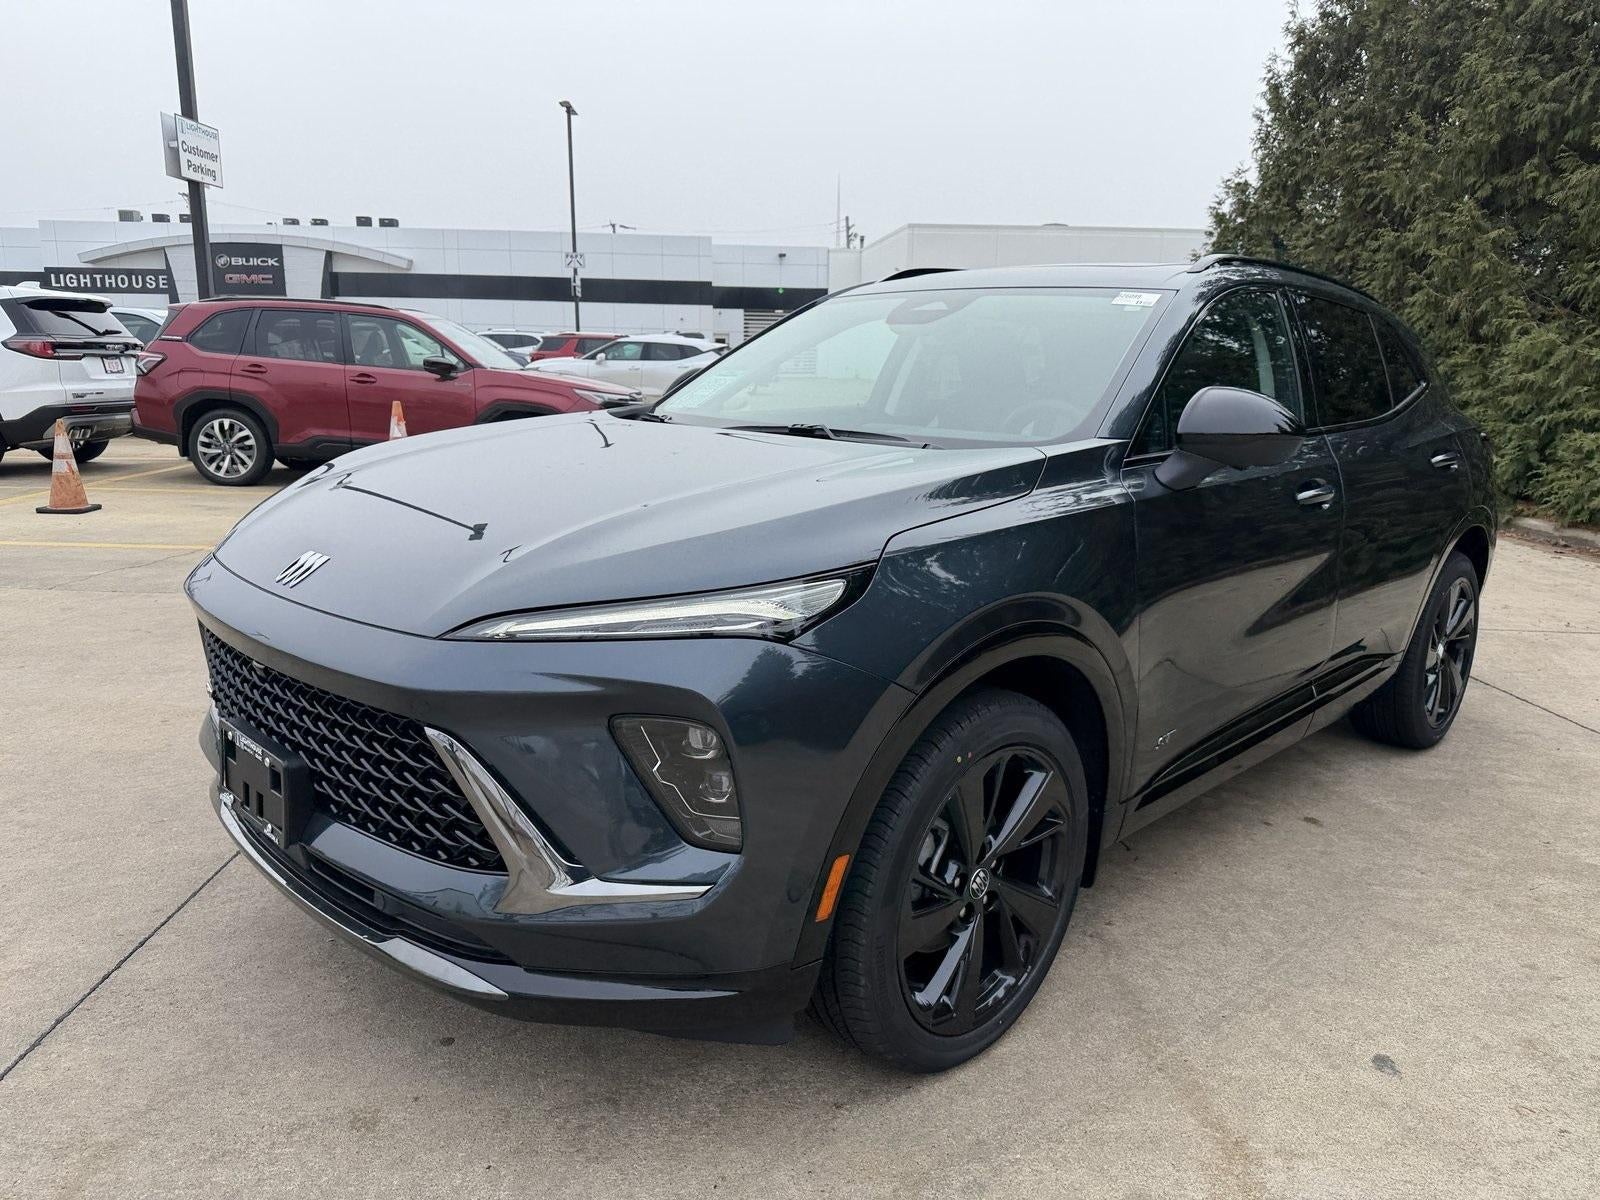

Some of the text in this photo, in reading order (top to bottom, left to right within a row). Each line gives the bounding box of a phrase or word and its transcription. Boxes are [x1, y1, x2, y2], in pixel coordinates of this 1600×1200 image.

[181, 140, 218, 163] Customer
[186, 159, 217, 181] Parking
[231, 256, 280, 267] BUICK
[50, 273, 169, 289] LIGHTHOUSE
[225, 273, 274, 285] GMC
